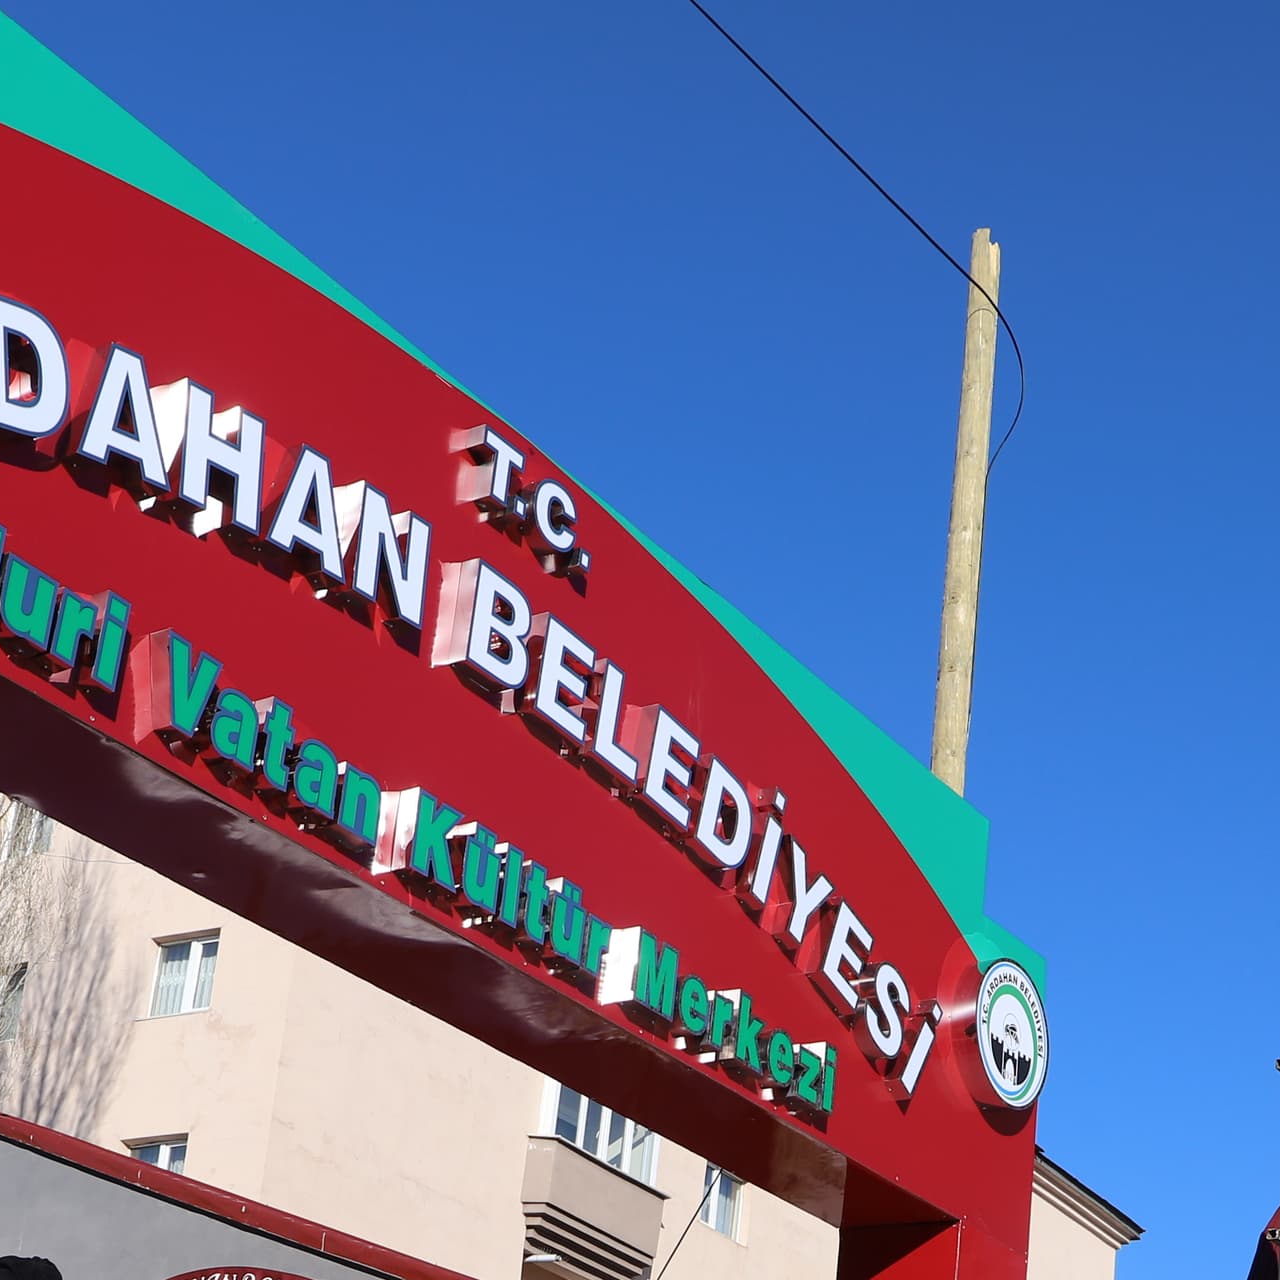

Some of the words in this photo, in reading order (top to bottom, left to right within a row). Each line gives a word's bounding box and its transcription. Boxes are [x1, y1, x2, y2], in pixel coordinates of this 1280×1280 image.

[484, 425, 591, 572] T.C.
[168, 628, 382, 843] Vatan
[410, 787, 613, 976] Kültür
[631, 928, 837, 1114] Merkezi
[465, 558, 943, 1098] BELEDİYESİ
[987, 972, 1018, 999] ARDAHAN
